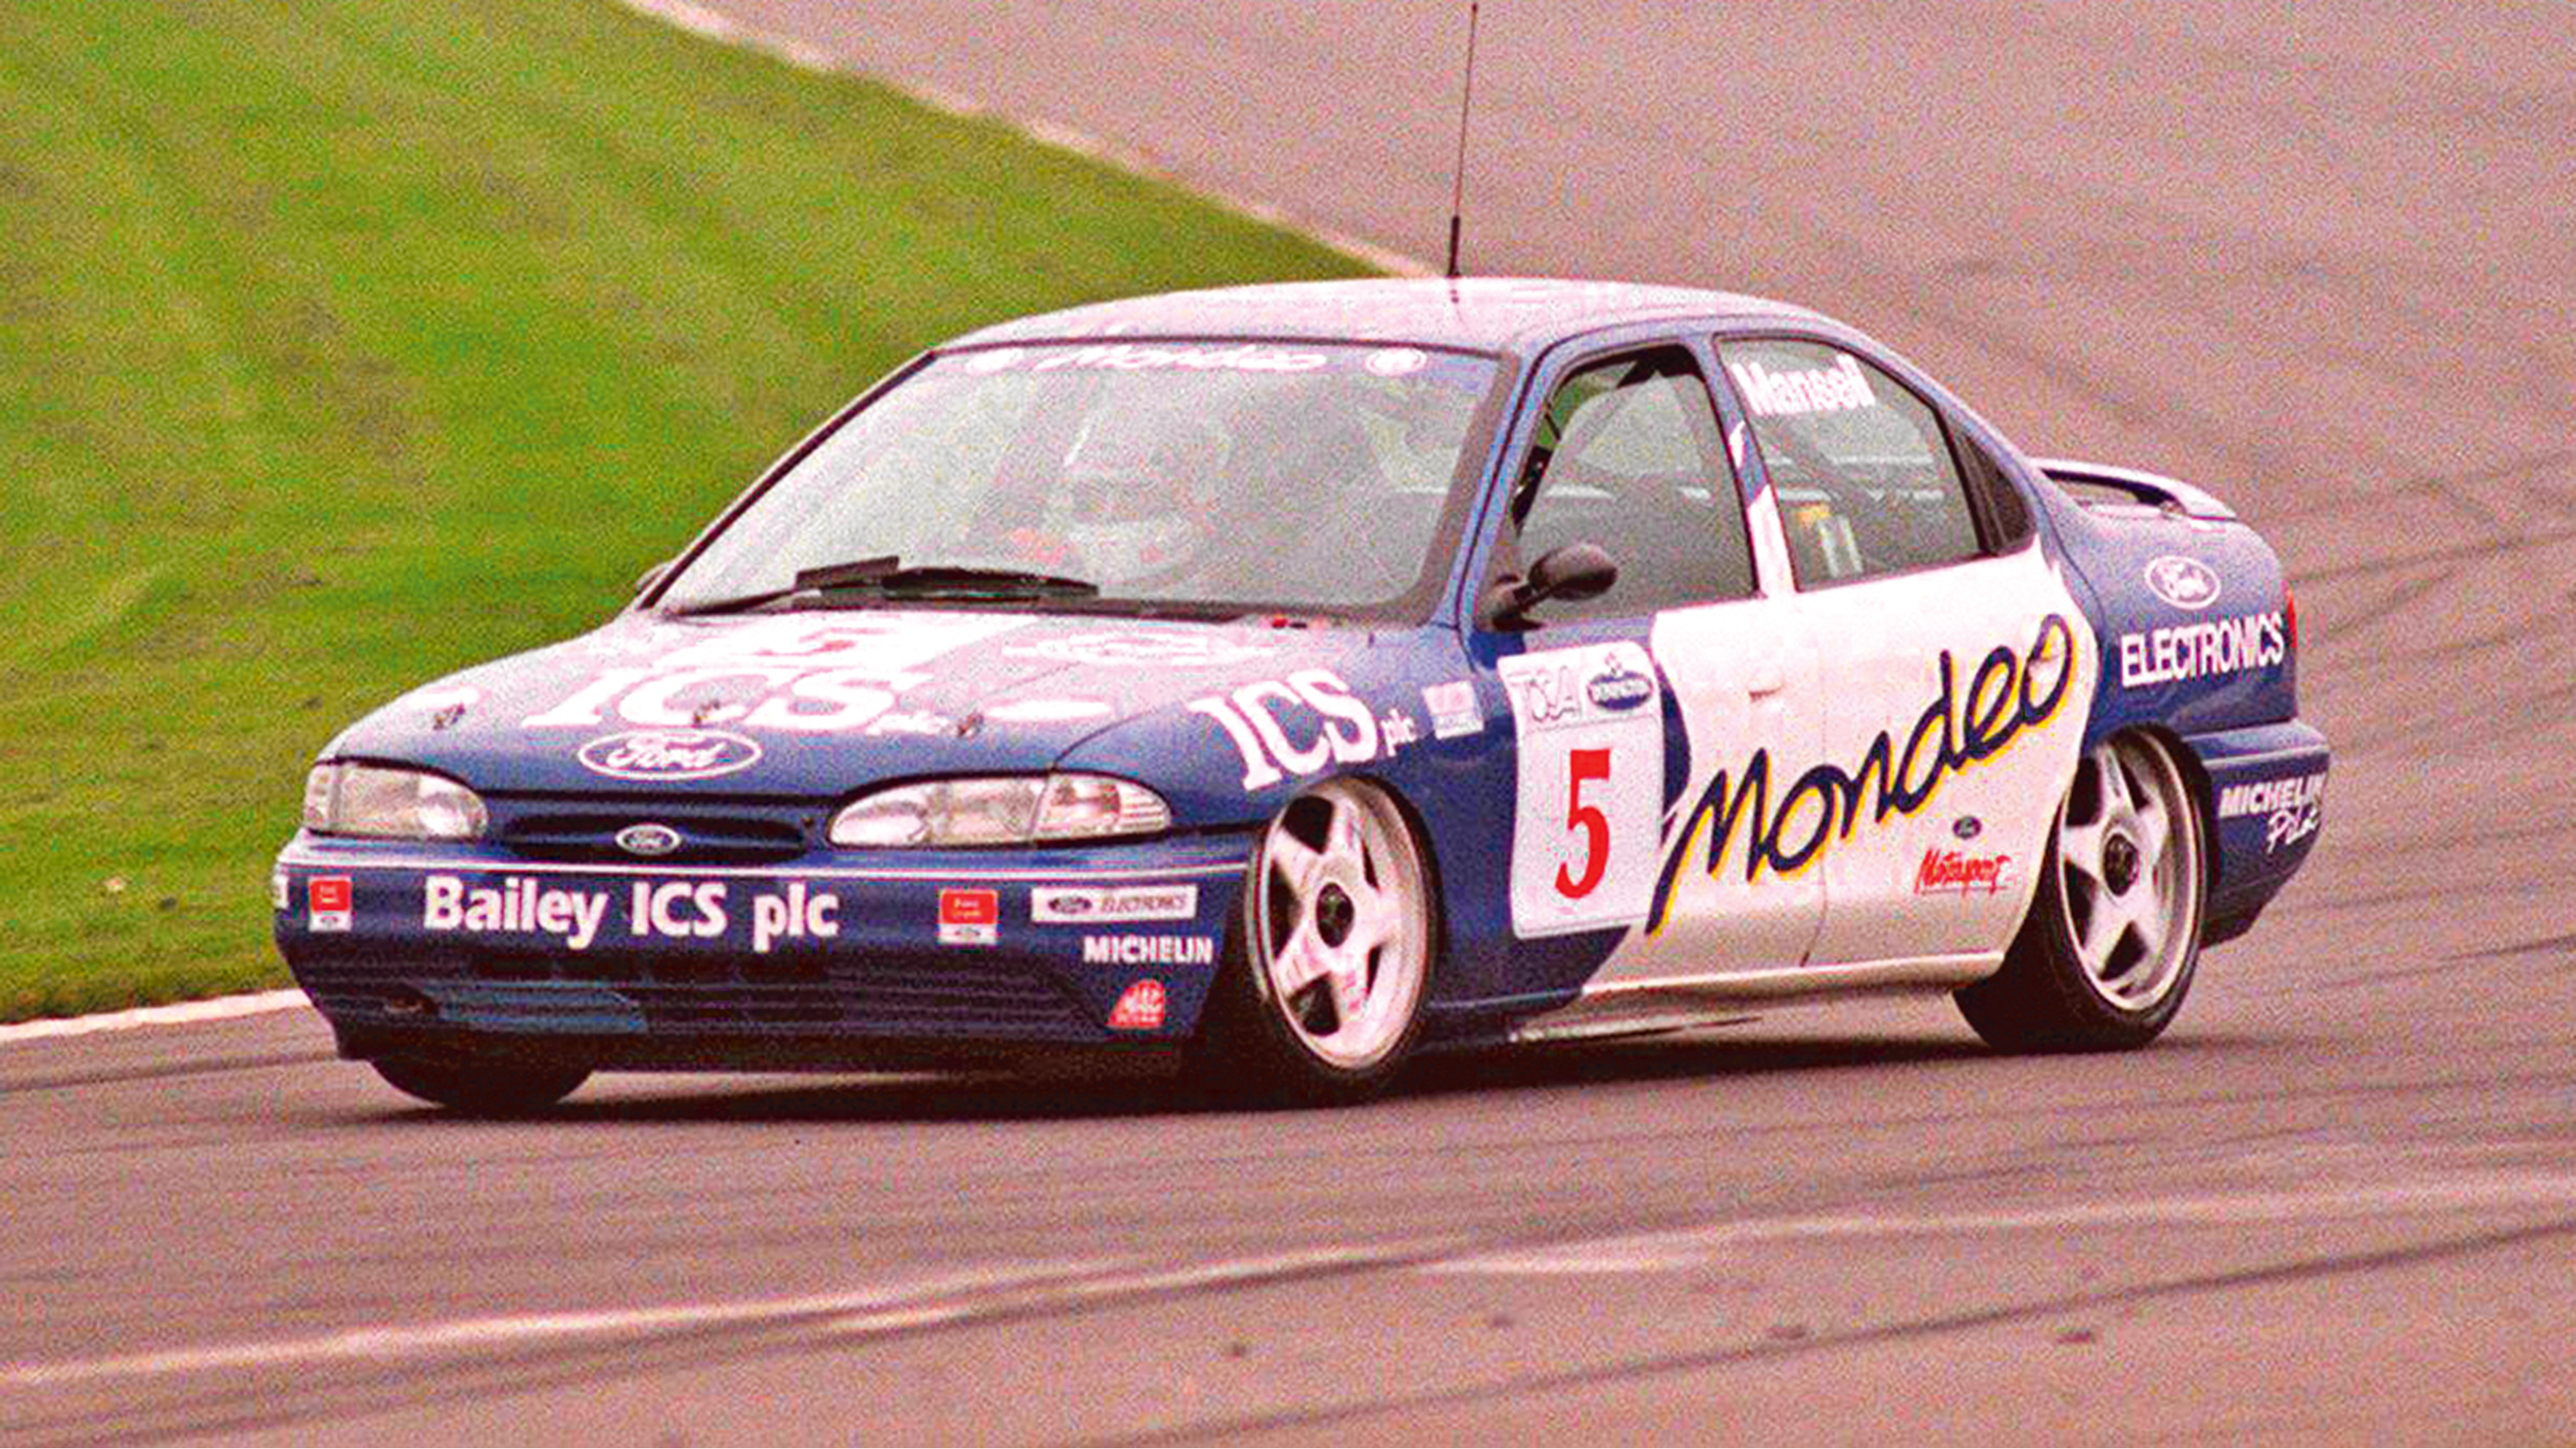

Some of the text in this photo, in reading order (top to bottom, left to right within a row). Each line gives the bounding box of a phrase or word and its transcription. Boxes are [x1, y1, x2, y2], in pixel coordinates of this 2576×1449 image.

[2121, 611, 2285, 687] ELECTRONICS
[521, 667, 896, 729] ICS
[1187, 668, 1378, 791] ICS
[1645, 613, 2073, 936] Mondeo
[1554, 748, 1611, 899] 5
[423, 875, 840, 952] Bailey ICS plc
[1083, 935, 1213, 964] MICHELIN
